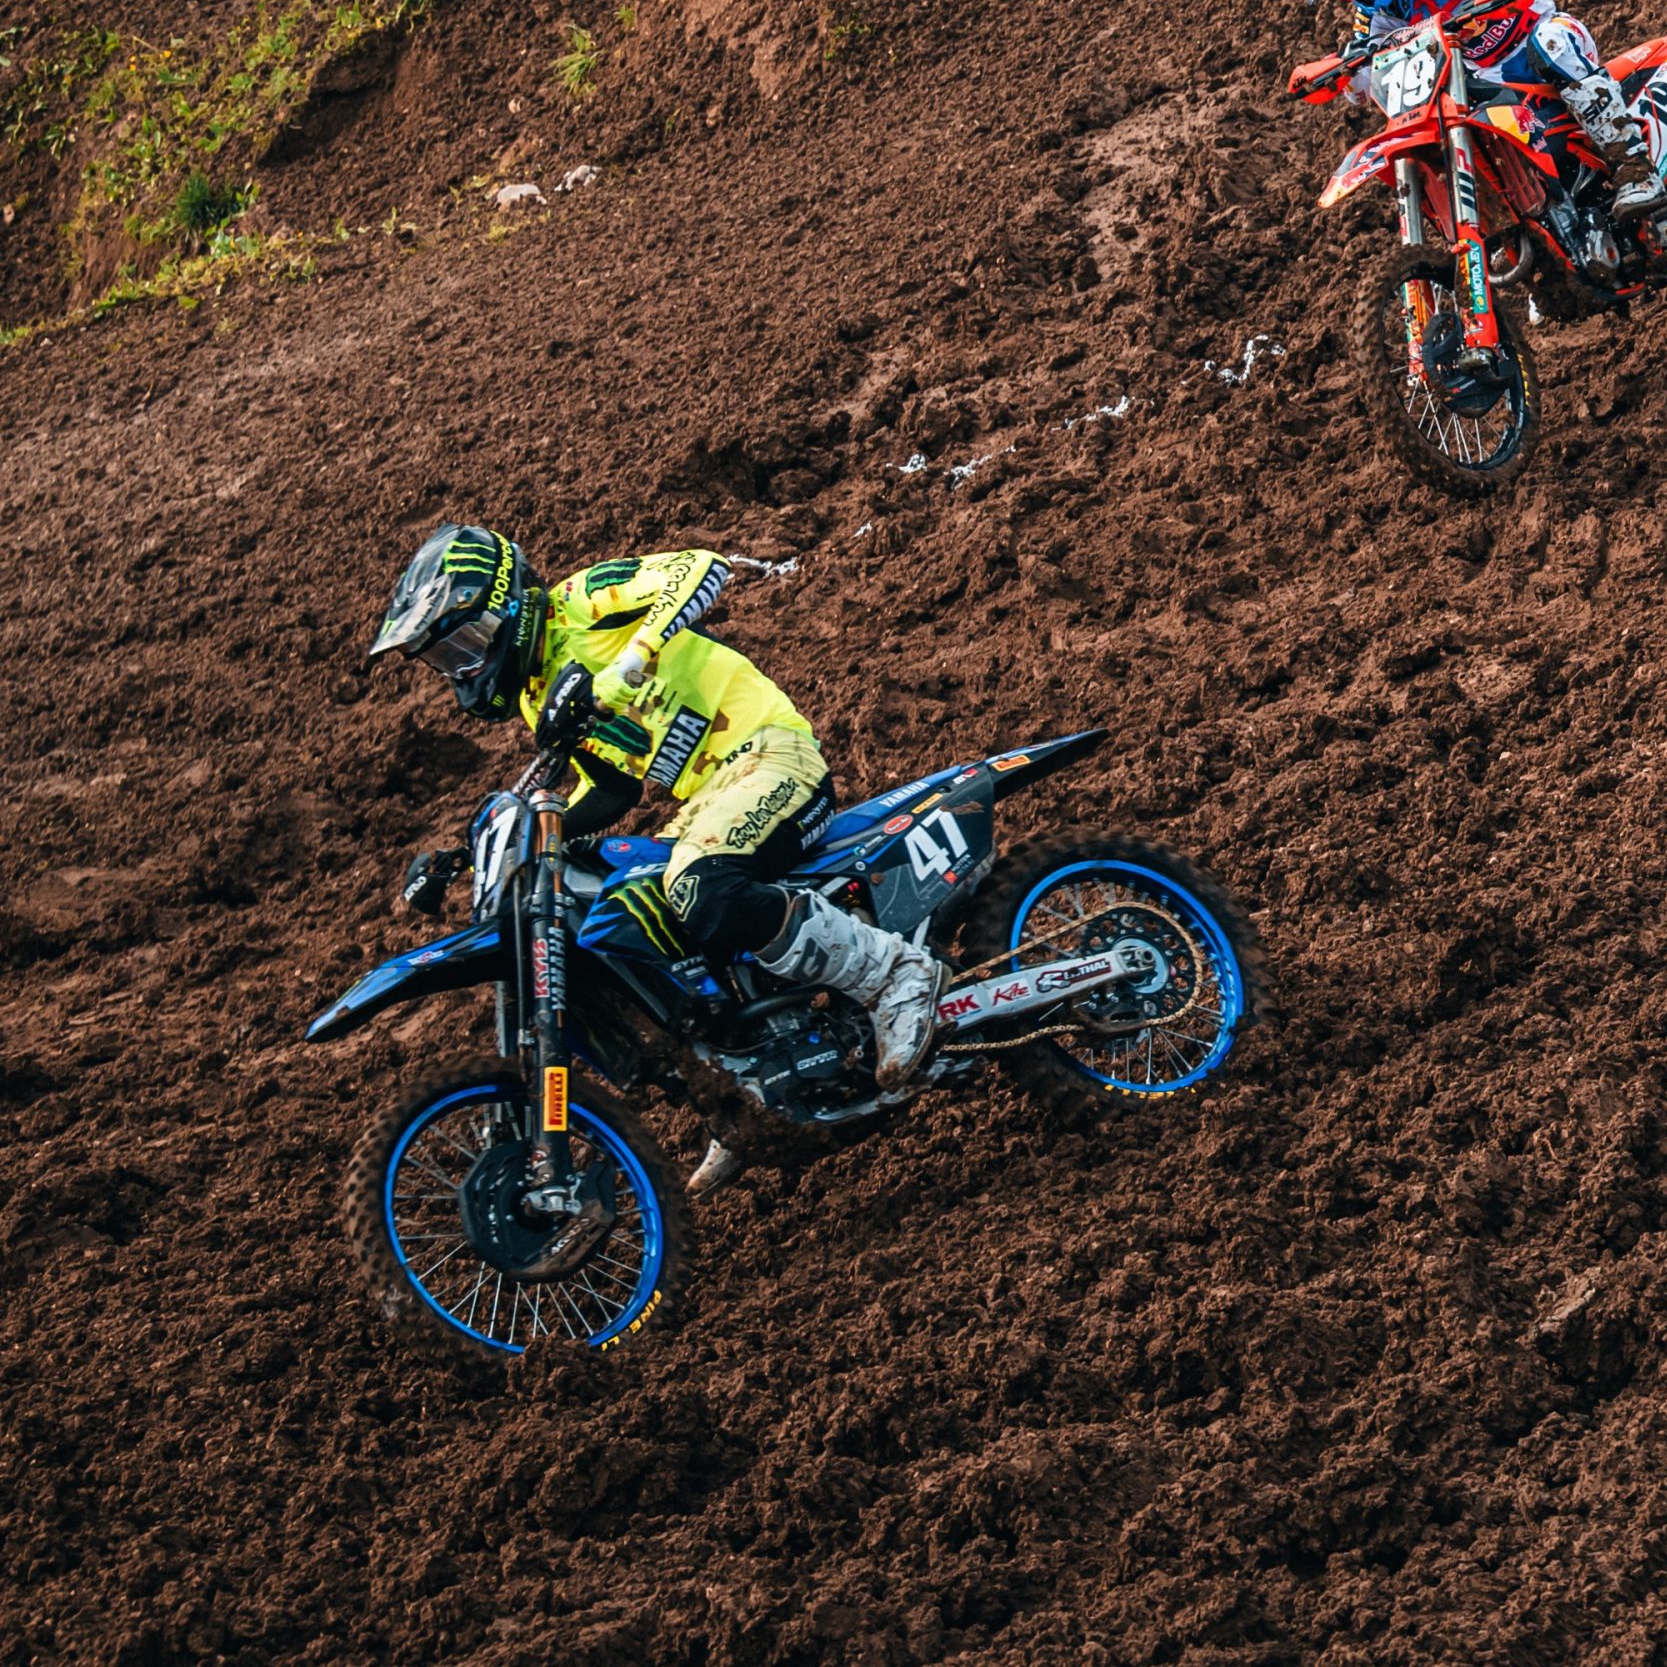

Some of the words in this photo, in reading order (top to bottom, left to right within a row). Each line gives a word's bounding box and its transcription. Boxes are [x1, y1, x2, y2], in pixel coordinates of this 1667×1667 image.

[1465, 31, 1492, 59] Red
[1381, 49, 1436, 119] 19
[1469, 246, 1483, 296] MOTOREX
[662, 563, 731, 642] YAMAHA
[878, 780, 930, 808] YAMAHA
[905, 809, 969, 882] 47
[534, 937, 550, 998] KYB
[549, 926, 567, 1011] YAMAHA
[938, 992, 980, 1019] RK
[992, 985, 1031, 1007] Kite
[548, 1072, 564, 1127] PIRELLI
